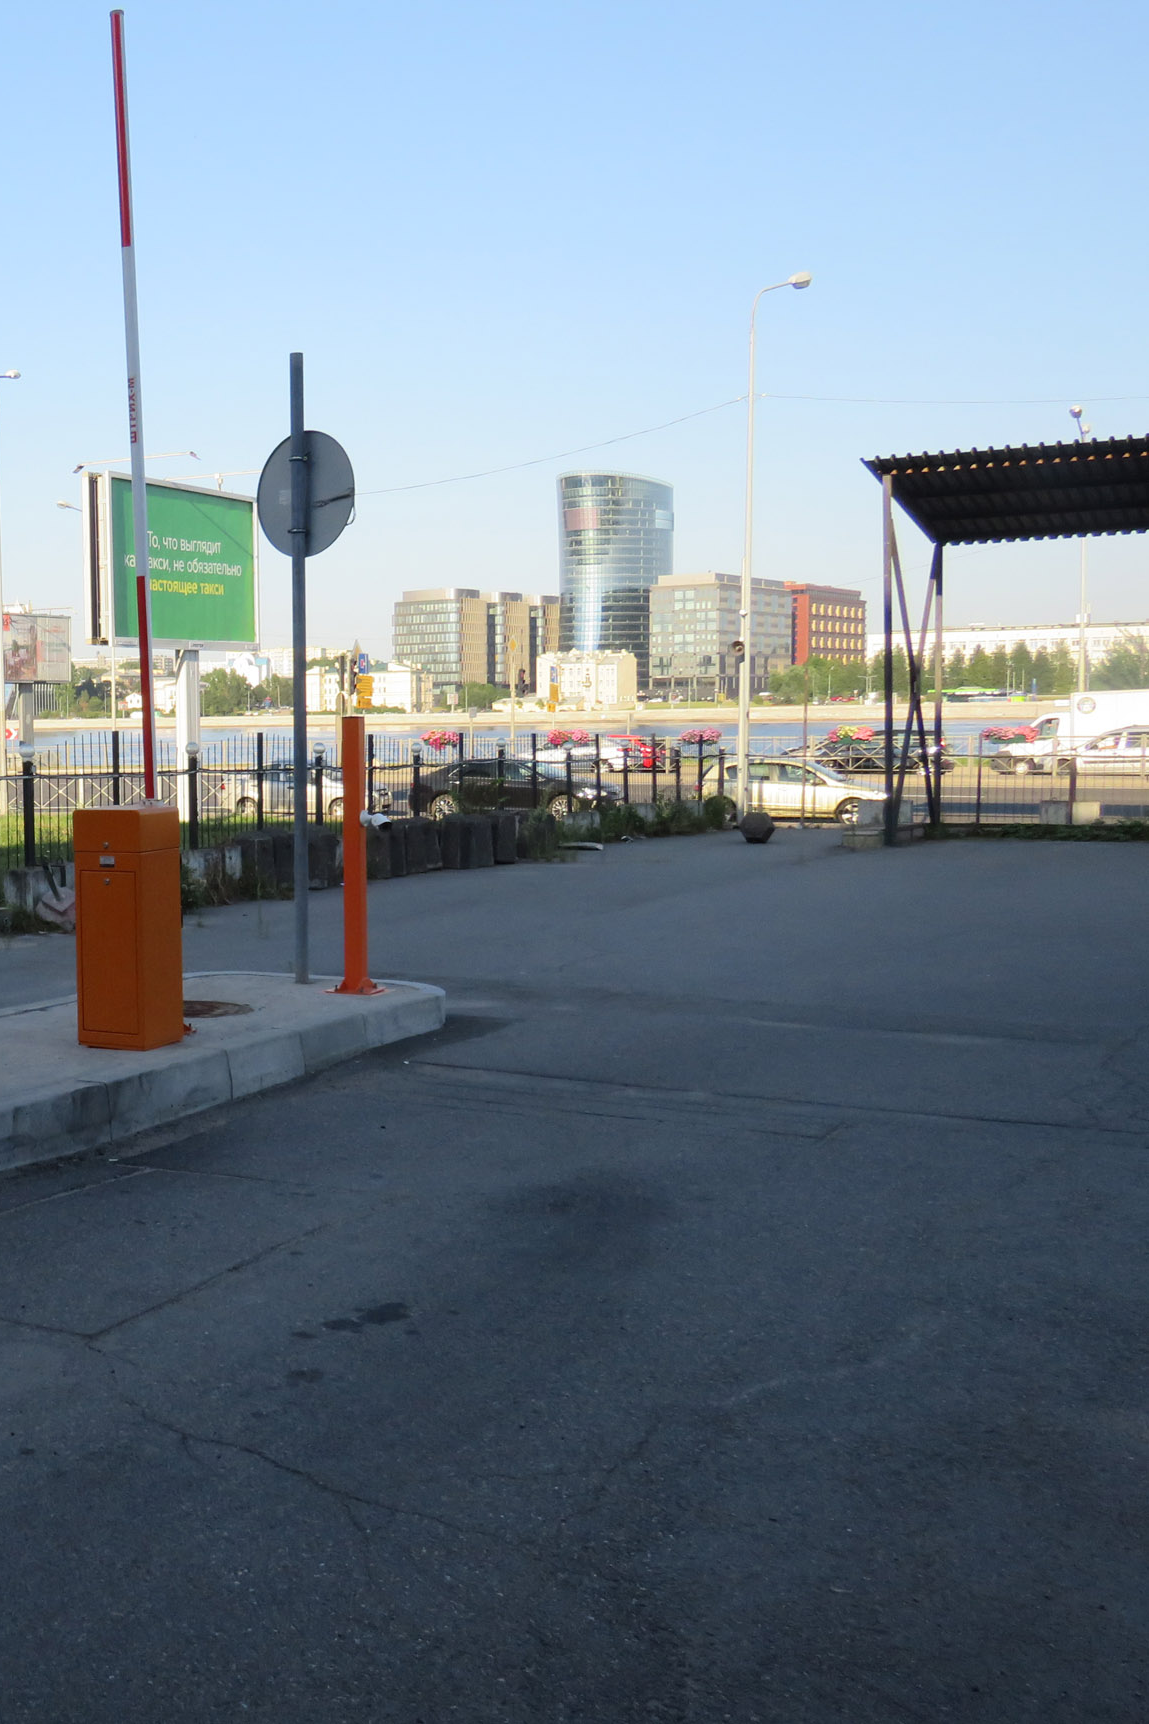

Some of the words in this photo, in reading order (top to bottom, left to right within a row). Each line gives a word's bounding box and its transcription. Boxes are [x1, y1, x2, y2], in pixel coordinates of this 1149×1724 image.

[147, 530, 160, 550] То,
[162, 536, 178, 550] что
[180, 538, 221, 556] выглядит
[124, 554, 136, 568] ка
[148, 556, 171, 573] акси,
[173, 559, 185, 572] не
[187, 557, 242, 576] обязательно
[200, 582, 224, 596] такси
